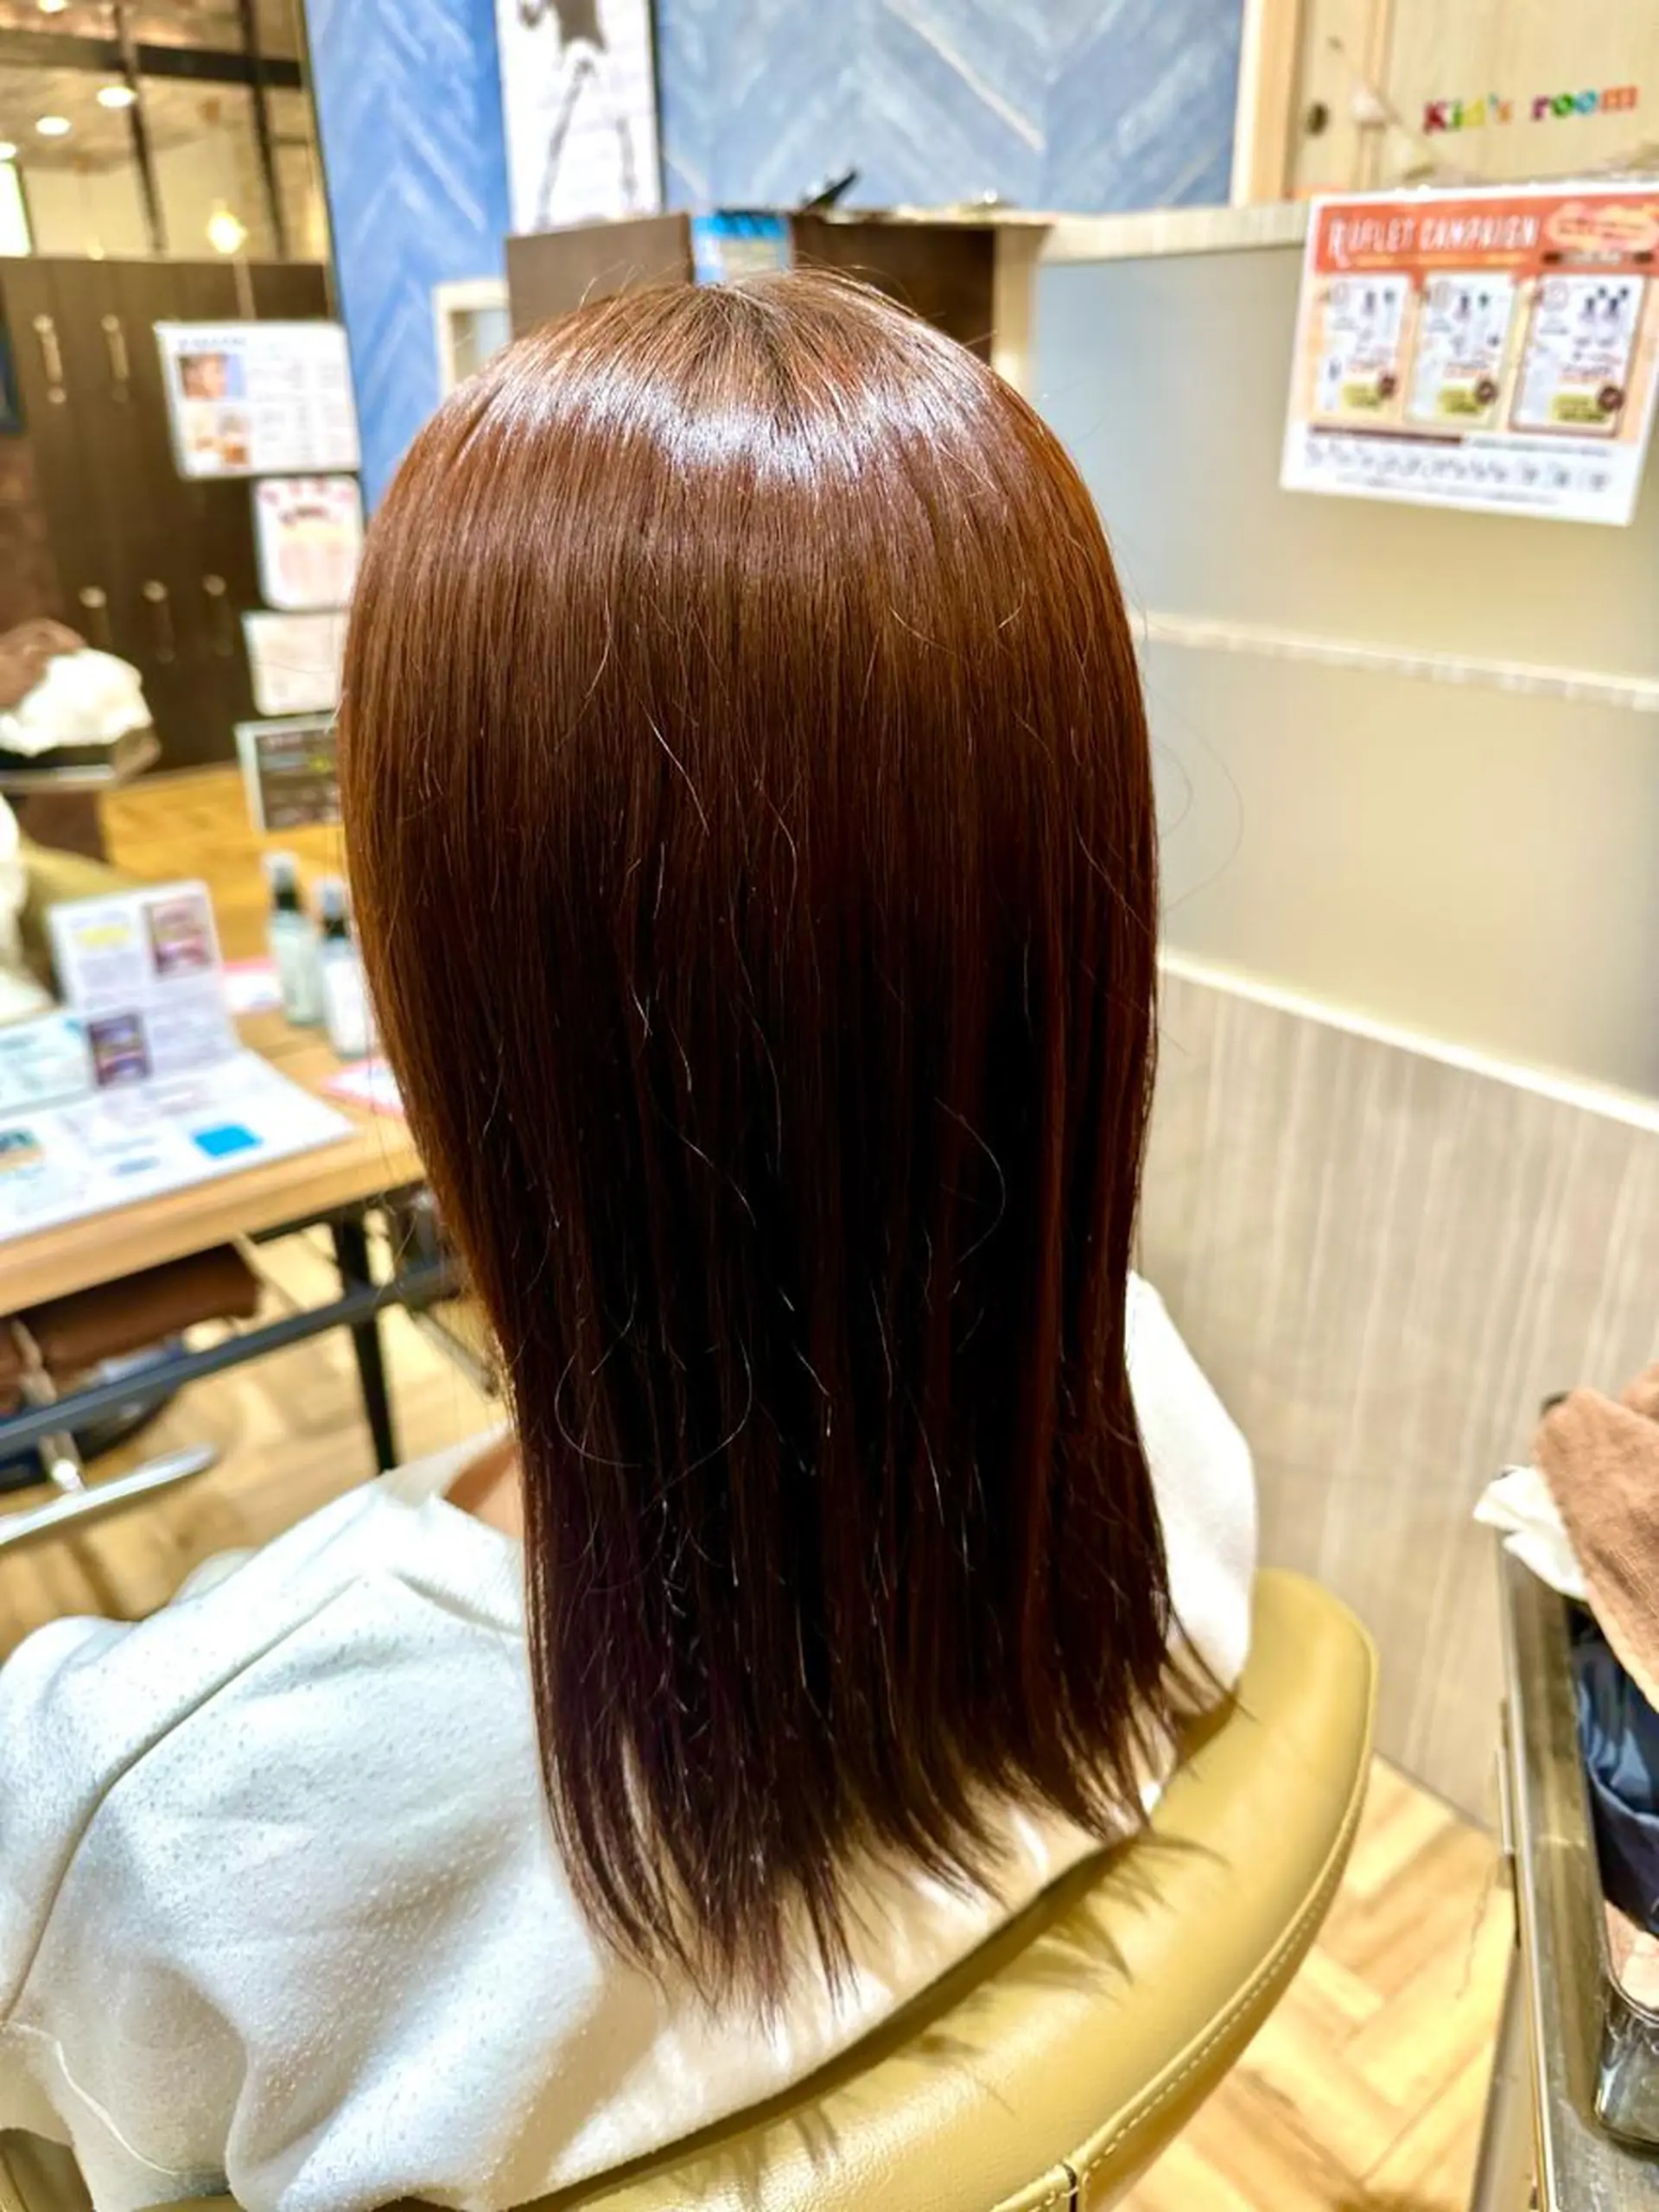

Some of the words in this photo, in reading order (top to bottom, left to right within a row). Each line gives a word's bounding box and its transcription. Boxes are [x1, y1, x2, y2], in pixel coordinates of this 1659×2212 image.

[1422, 92, 1513, 135] Kid's
[1530, 86, 1638, 122] room
[1420, 214, 1540, 251] CAMPAIGN
